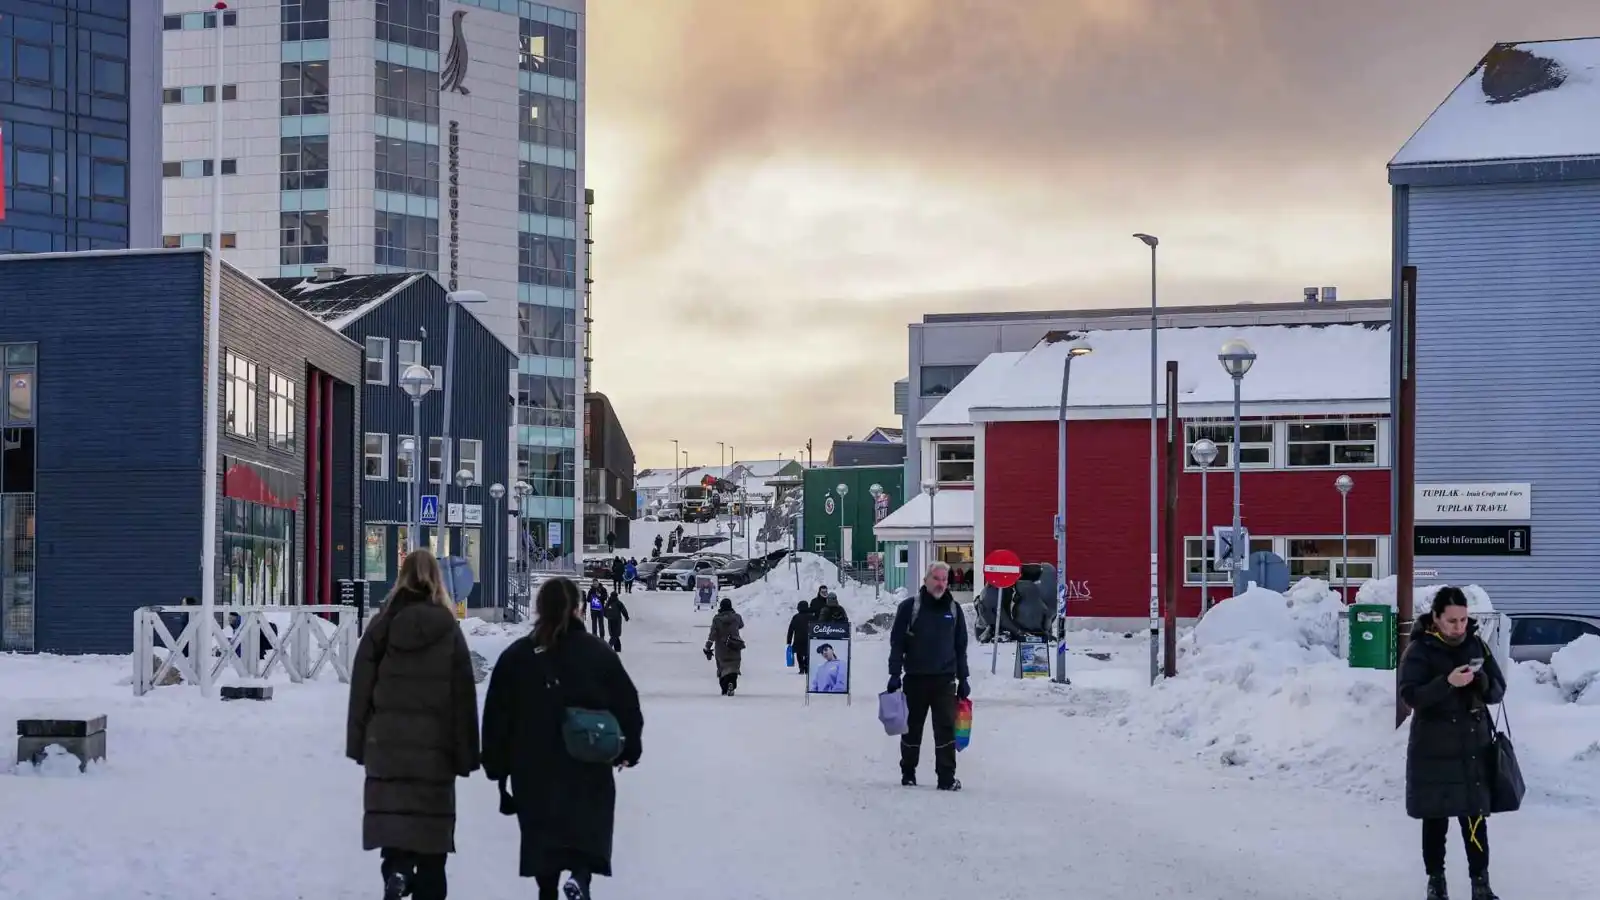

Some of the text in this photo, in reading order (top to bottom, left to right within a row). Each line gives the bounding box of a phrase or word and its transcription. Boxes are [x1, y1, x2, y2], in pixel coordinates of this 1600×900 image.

[1422, 489, 1459, 497] TUPILAK
[1437, 504, 1508, 512] TUPILAK TRAVEL
[1418, 535, 1450, 544] Tourist
[1452, 535, 1505, 544] information
[813, 624, 846, 635] California
